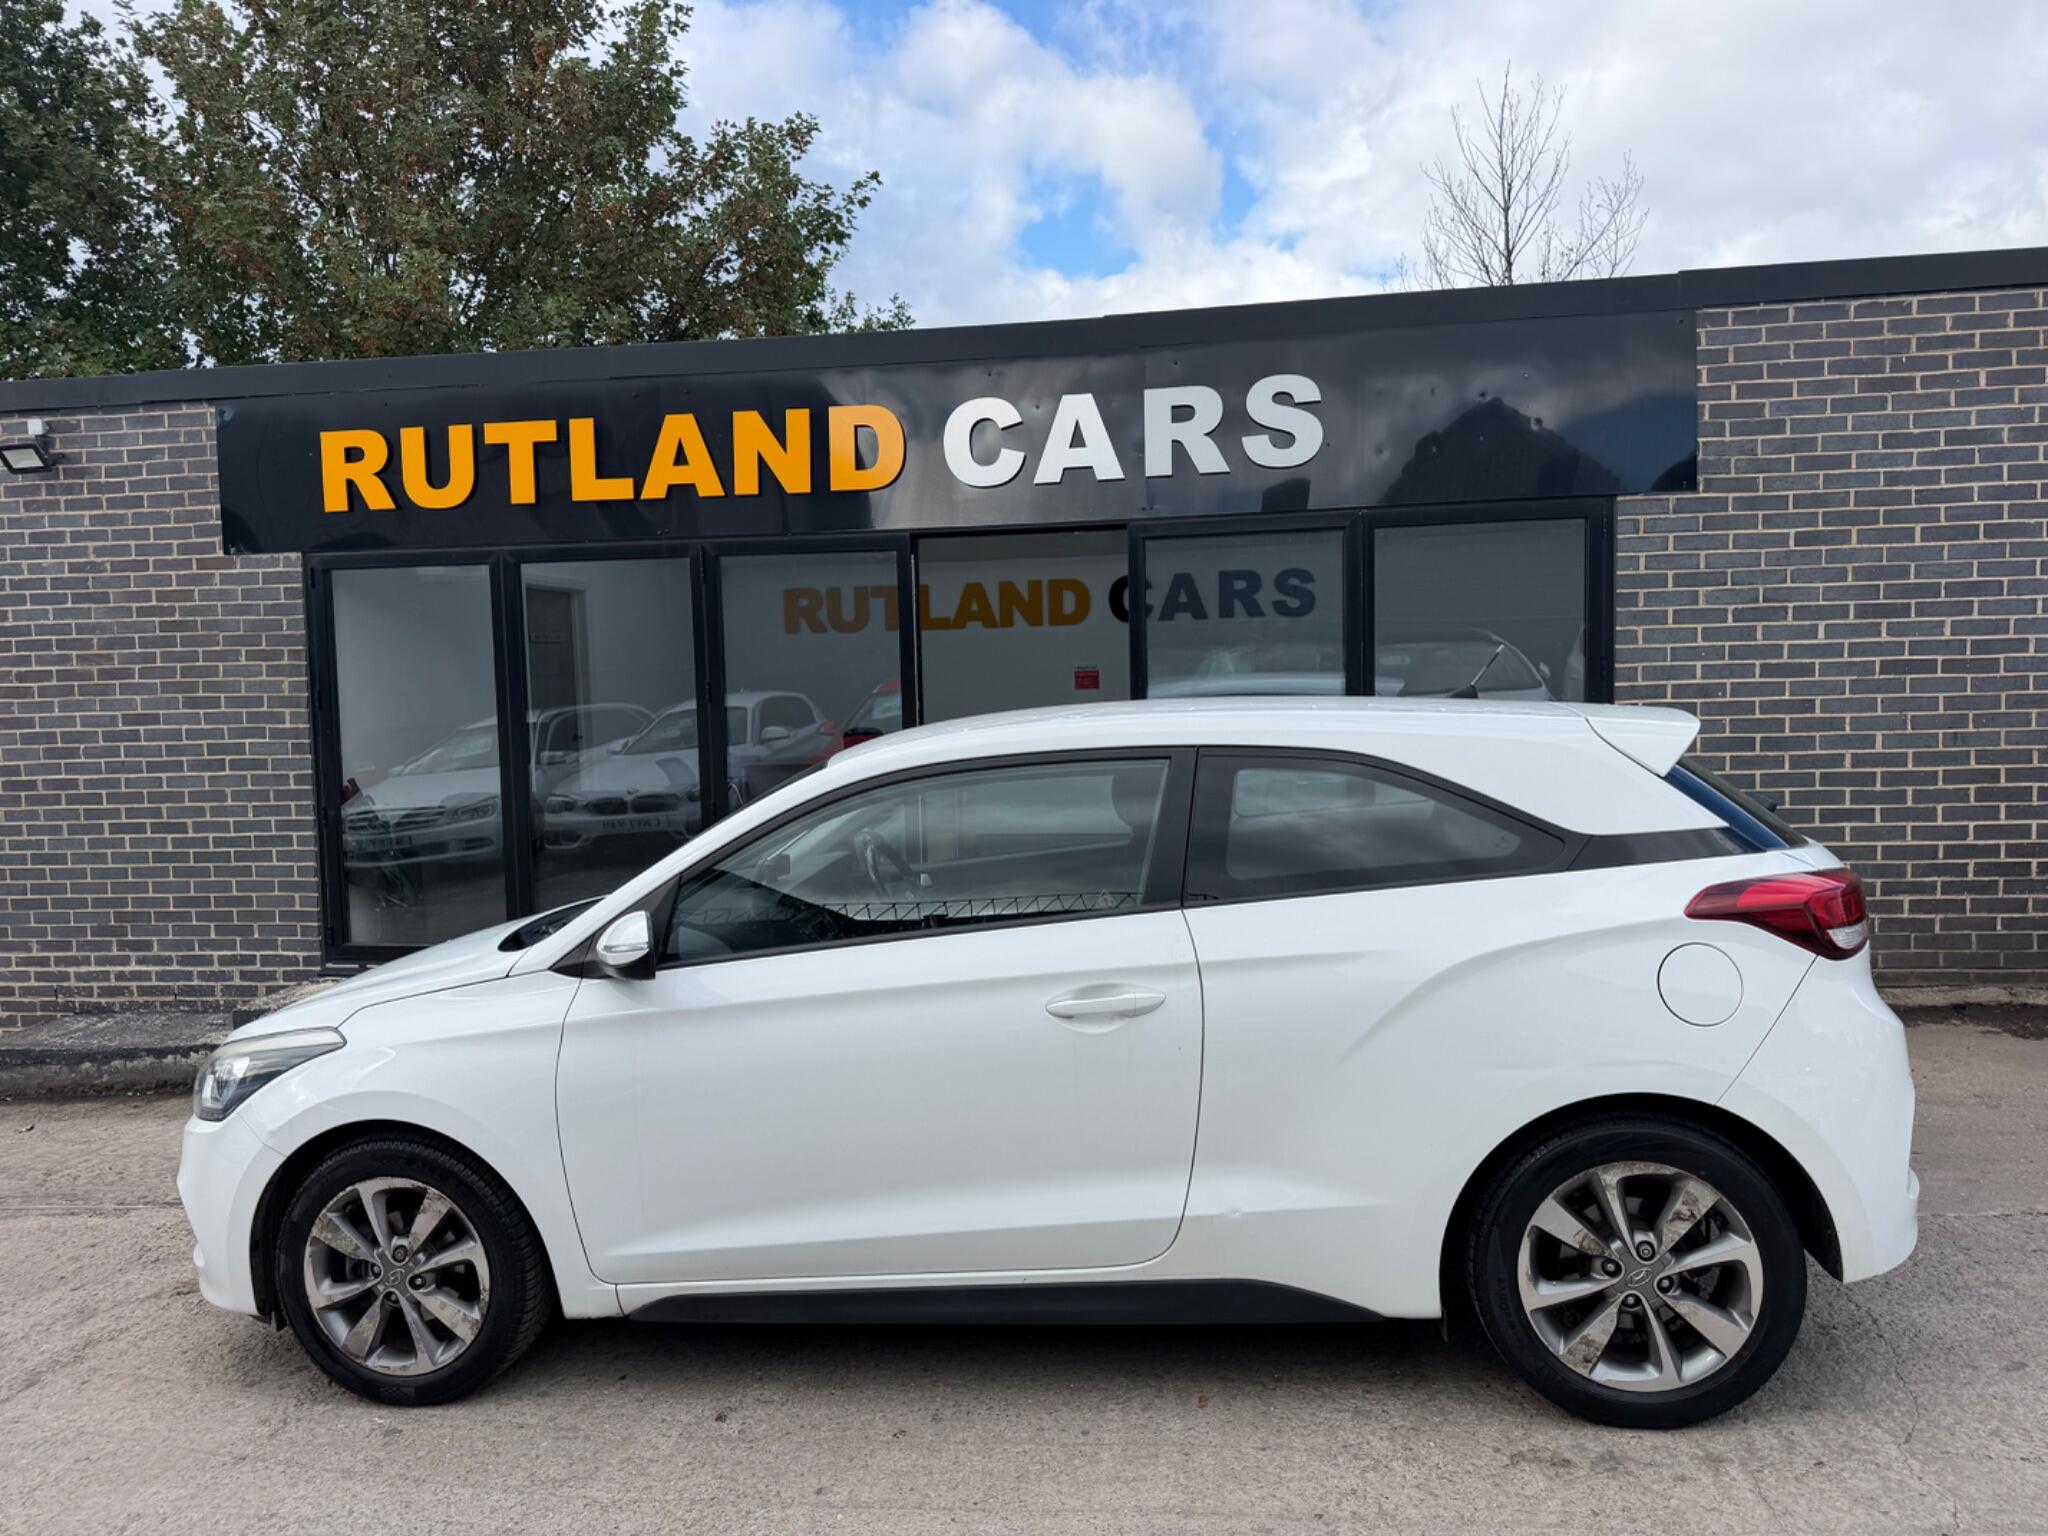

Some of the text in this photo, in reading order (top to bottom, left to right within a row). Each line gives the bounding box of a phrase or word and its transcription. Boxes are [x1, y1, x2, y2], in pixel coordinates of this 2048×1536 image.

[319, 374, 1324, 513] RUTLAND CARS
[783, 567, 1316, 634] RUTLAND CARS
